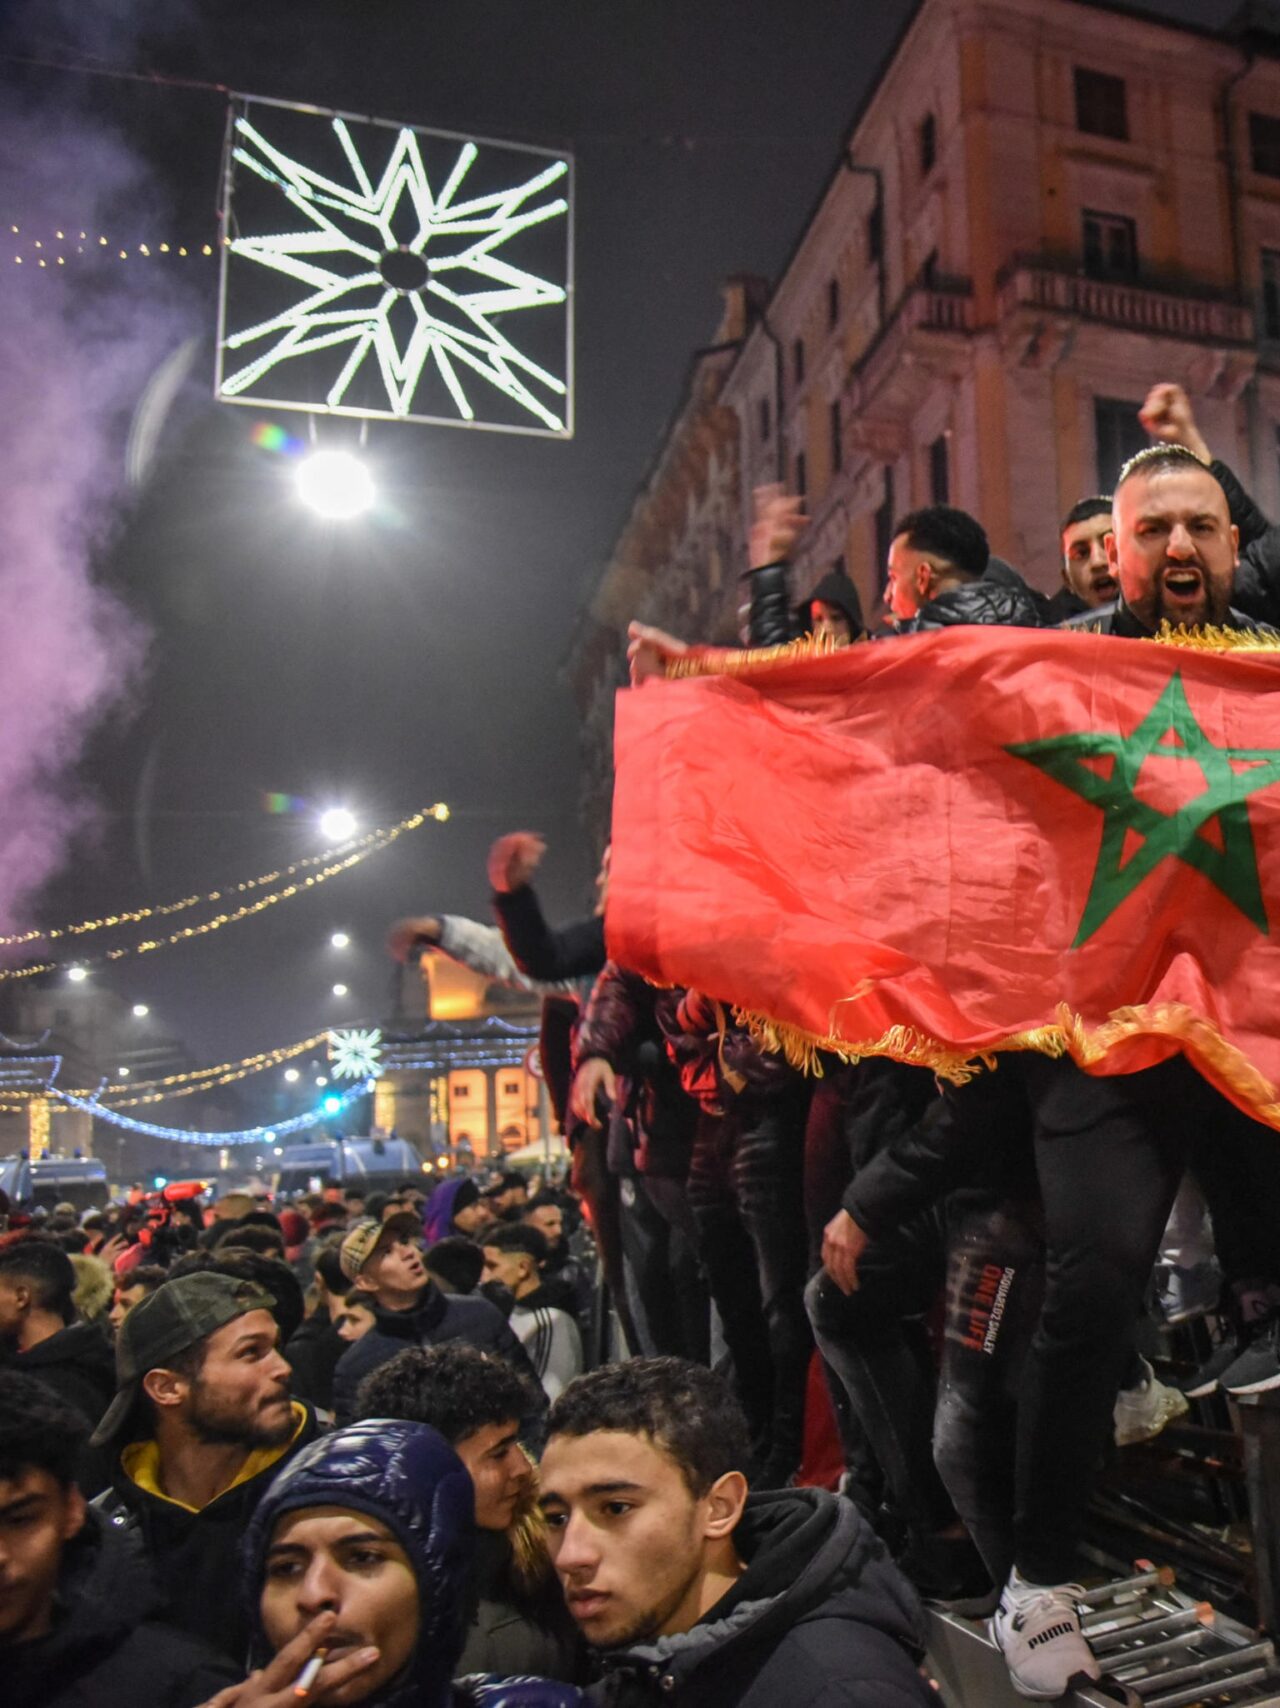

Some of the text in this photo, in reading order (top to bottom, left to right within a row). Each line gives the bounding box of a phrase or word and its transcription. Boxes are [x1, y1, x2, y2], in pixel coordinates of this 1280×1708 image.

[963, 1264, 1002, 1352] ONE LIFE
[1028, 1621, 1075, 1650] PUMA
